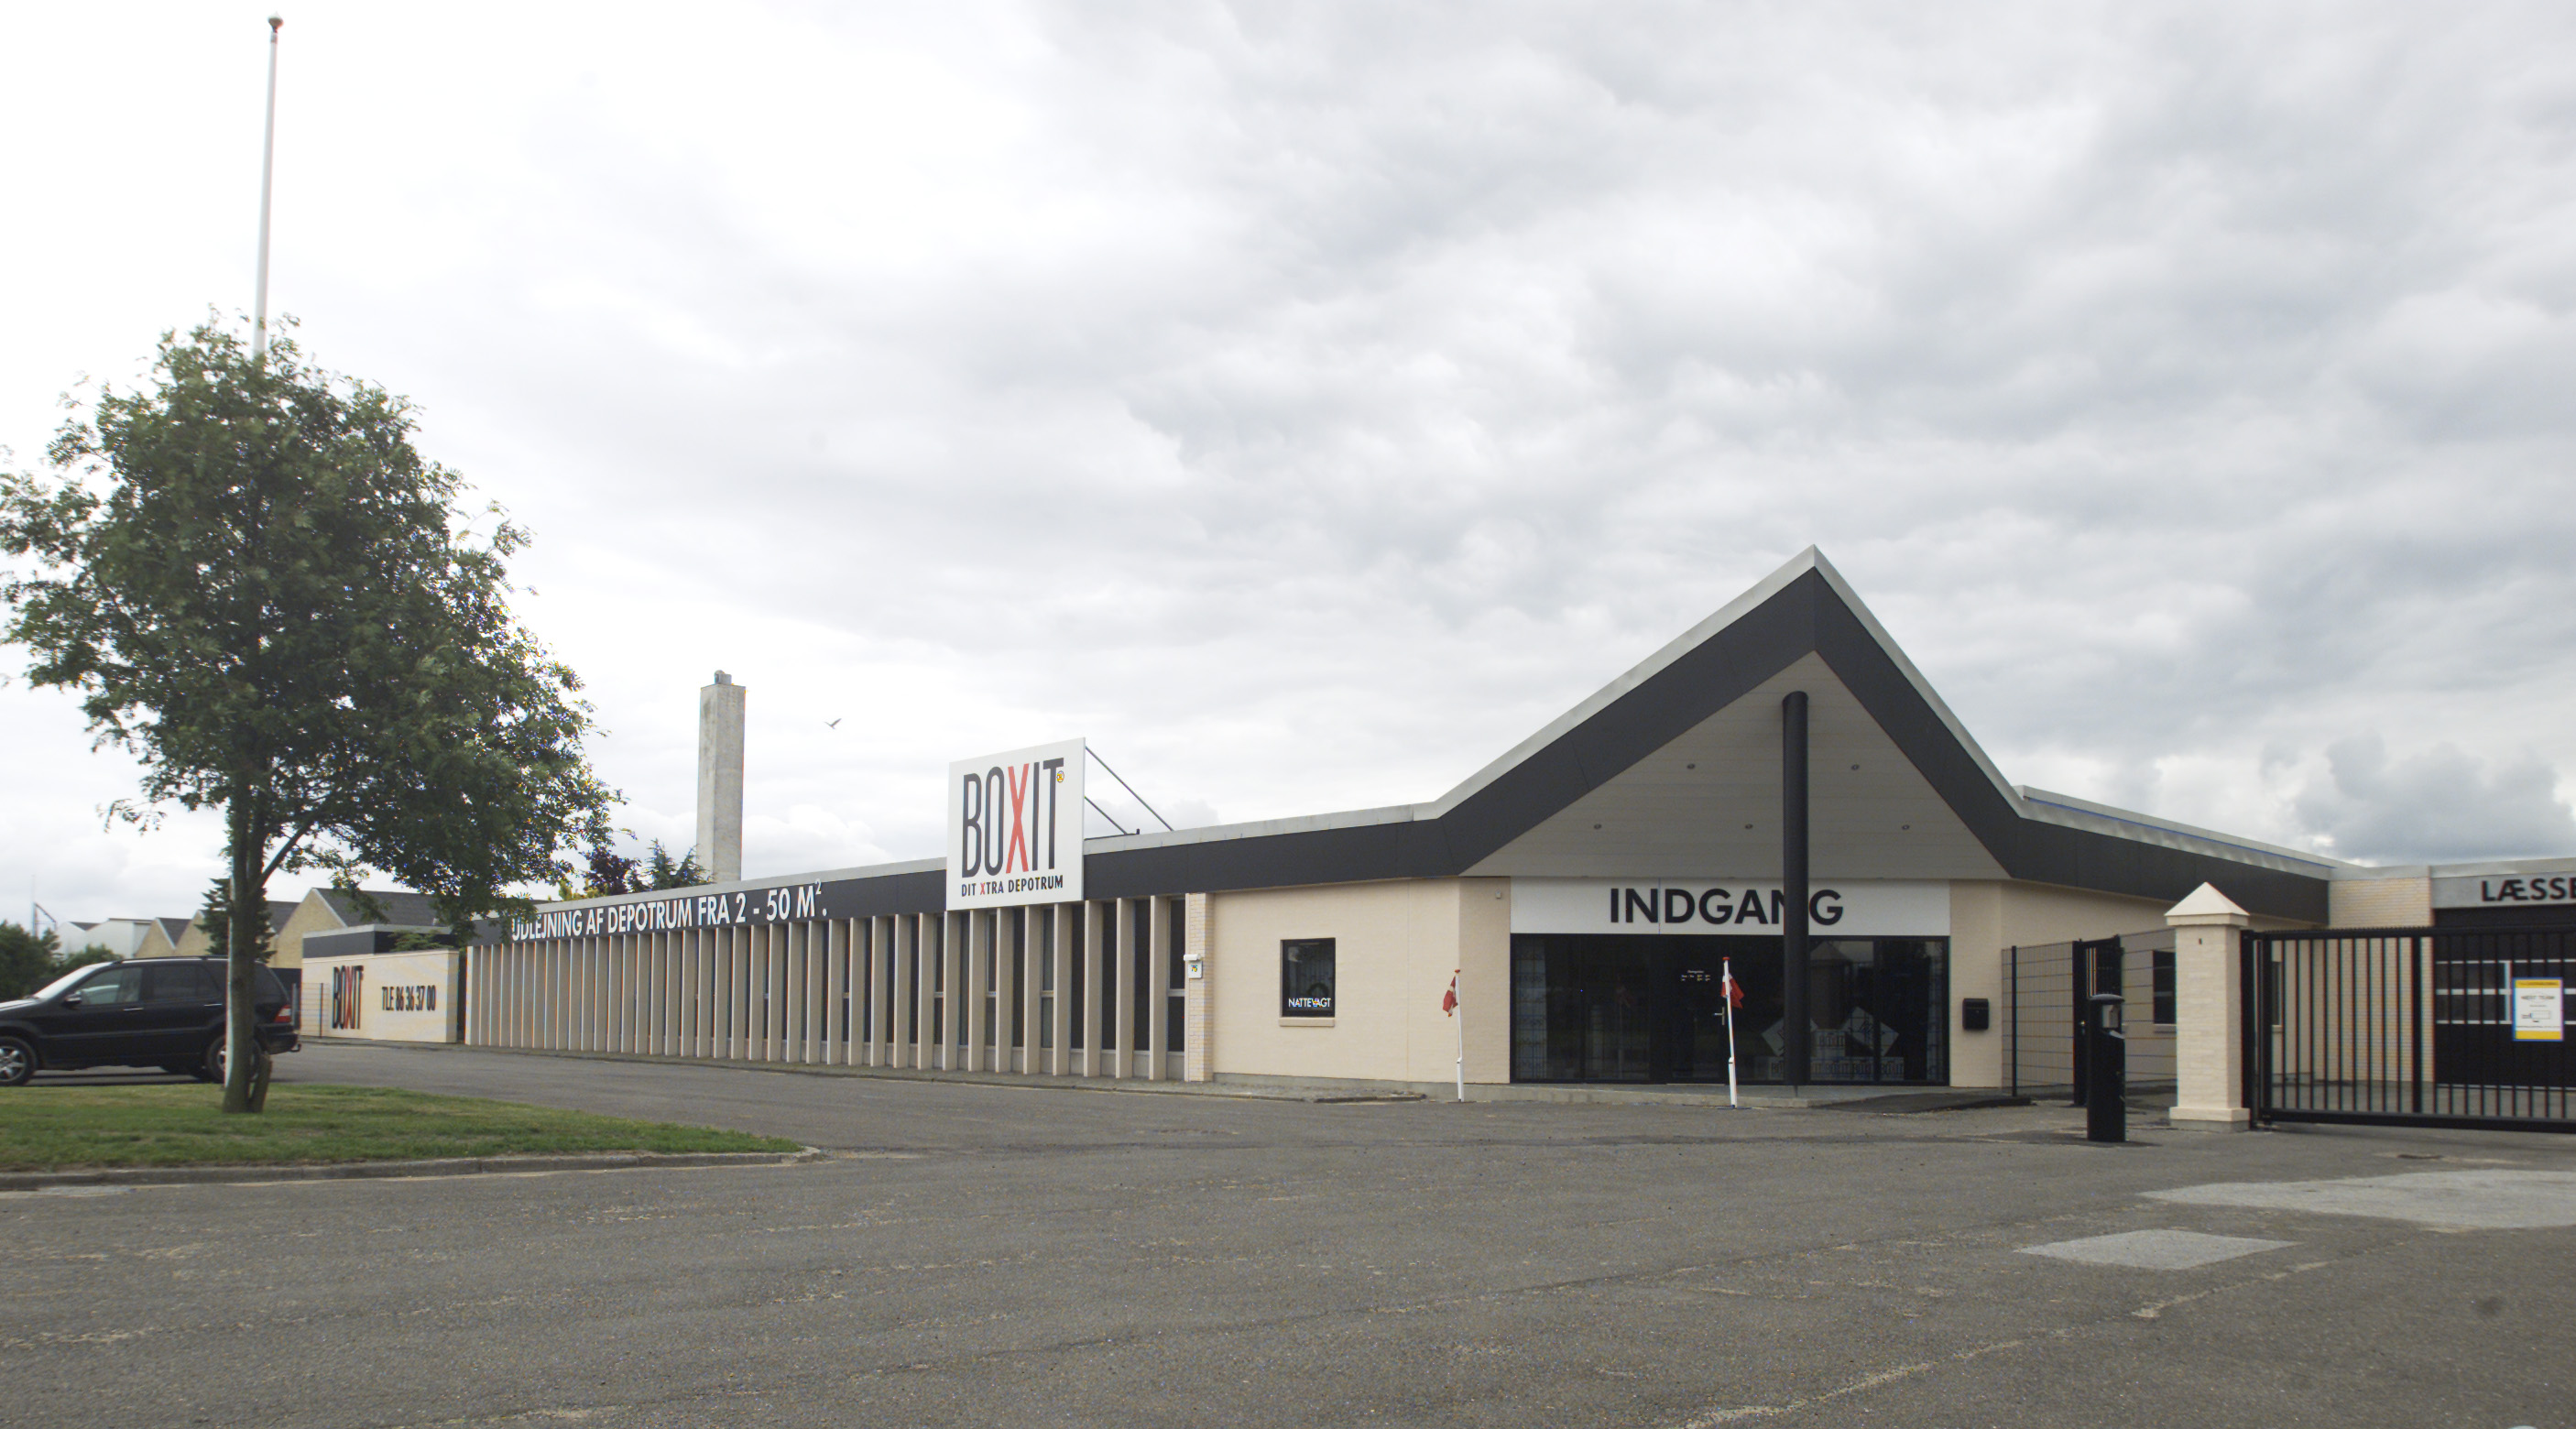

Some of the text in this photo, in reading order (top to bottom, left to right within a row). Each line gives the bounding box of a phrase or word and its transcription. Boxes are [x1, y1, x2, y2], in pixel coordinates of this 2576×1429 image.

[962, 758, 1064, 878] BOXIT
[962, 875, 1064, 897] DIT XTRA DEPOTRUM
[511, 910, 583, 941] UDLEJNING
[586, 908, 605, 935] AF
[608, 898, 693, 933] DEPOTRUM
[698, 894, 730, 925] FRA
[735, 892, 747, 922] 2
[766, 888, 791, 921] 50
[332, 965, 364, 1030] BOXIT
[1288, 998, 1332, 1008] NATTEVAGT
